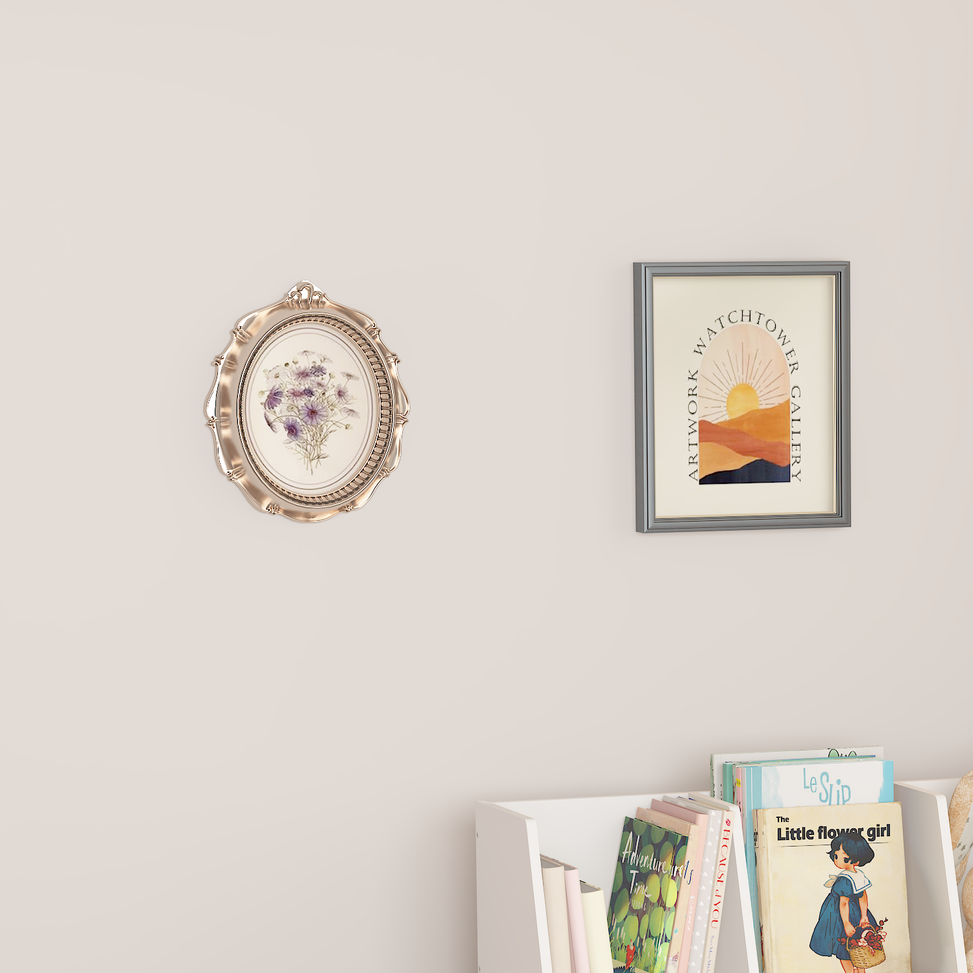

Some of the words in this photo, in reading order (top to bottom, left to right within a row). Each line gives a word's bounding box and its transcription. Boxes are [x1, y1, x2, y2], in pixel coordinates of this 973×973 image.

[687, 369, 699, 482] ARTWORK
[693, 309, 800, 374] WATCHTOWER
[790, 385, 802, 482] GALLERY
[803, 768, 817, 793] Le
[777, 827, 815, 841] Little
[866, 823, 891, 842] girl
[716, 829, 731, 887] BECAUSE
[710, 901, 722, 929] YOU
